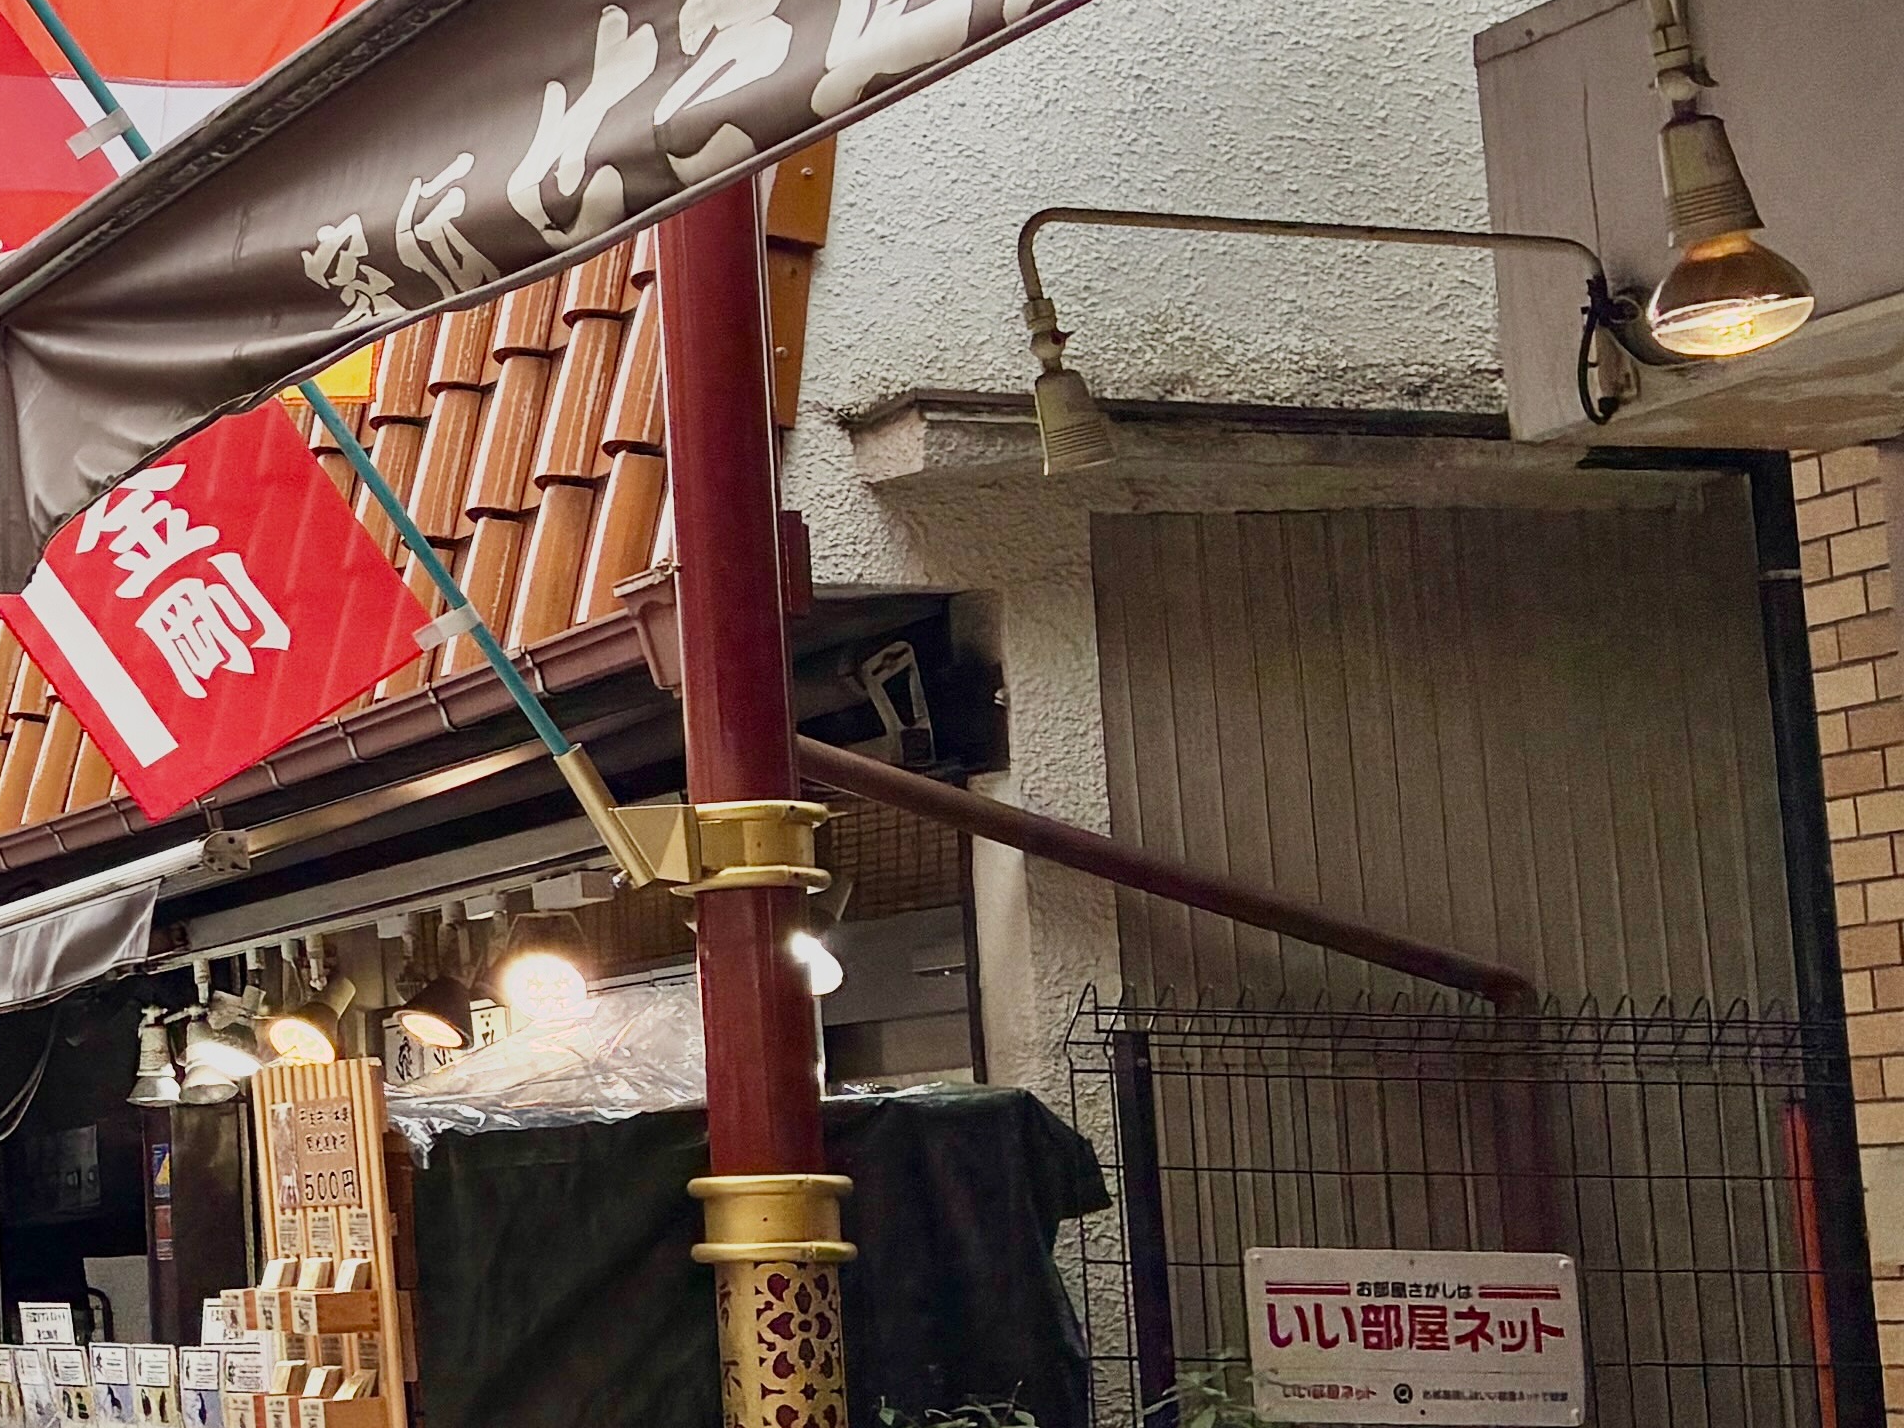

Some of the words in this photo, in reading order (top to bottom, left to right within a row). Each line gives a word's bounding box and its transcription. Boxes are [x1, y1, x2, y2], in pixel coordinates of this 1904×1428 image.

[303, 1169, 357, 1202] 500円
[1355, 1280, 1474, 1300] お部屋さがしは
[1265, 1302, 1566, 1354] いい部屋ネット
